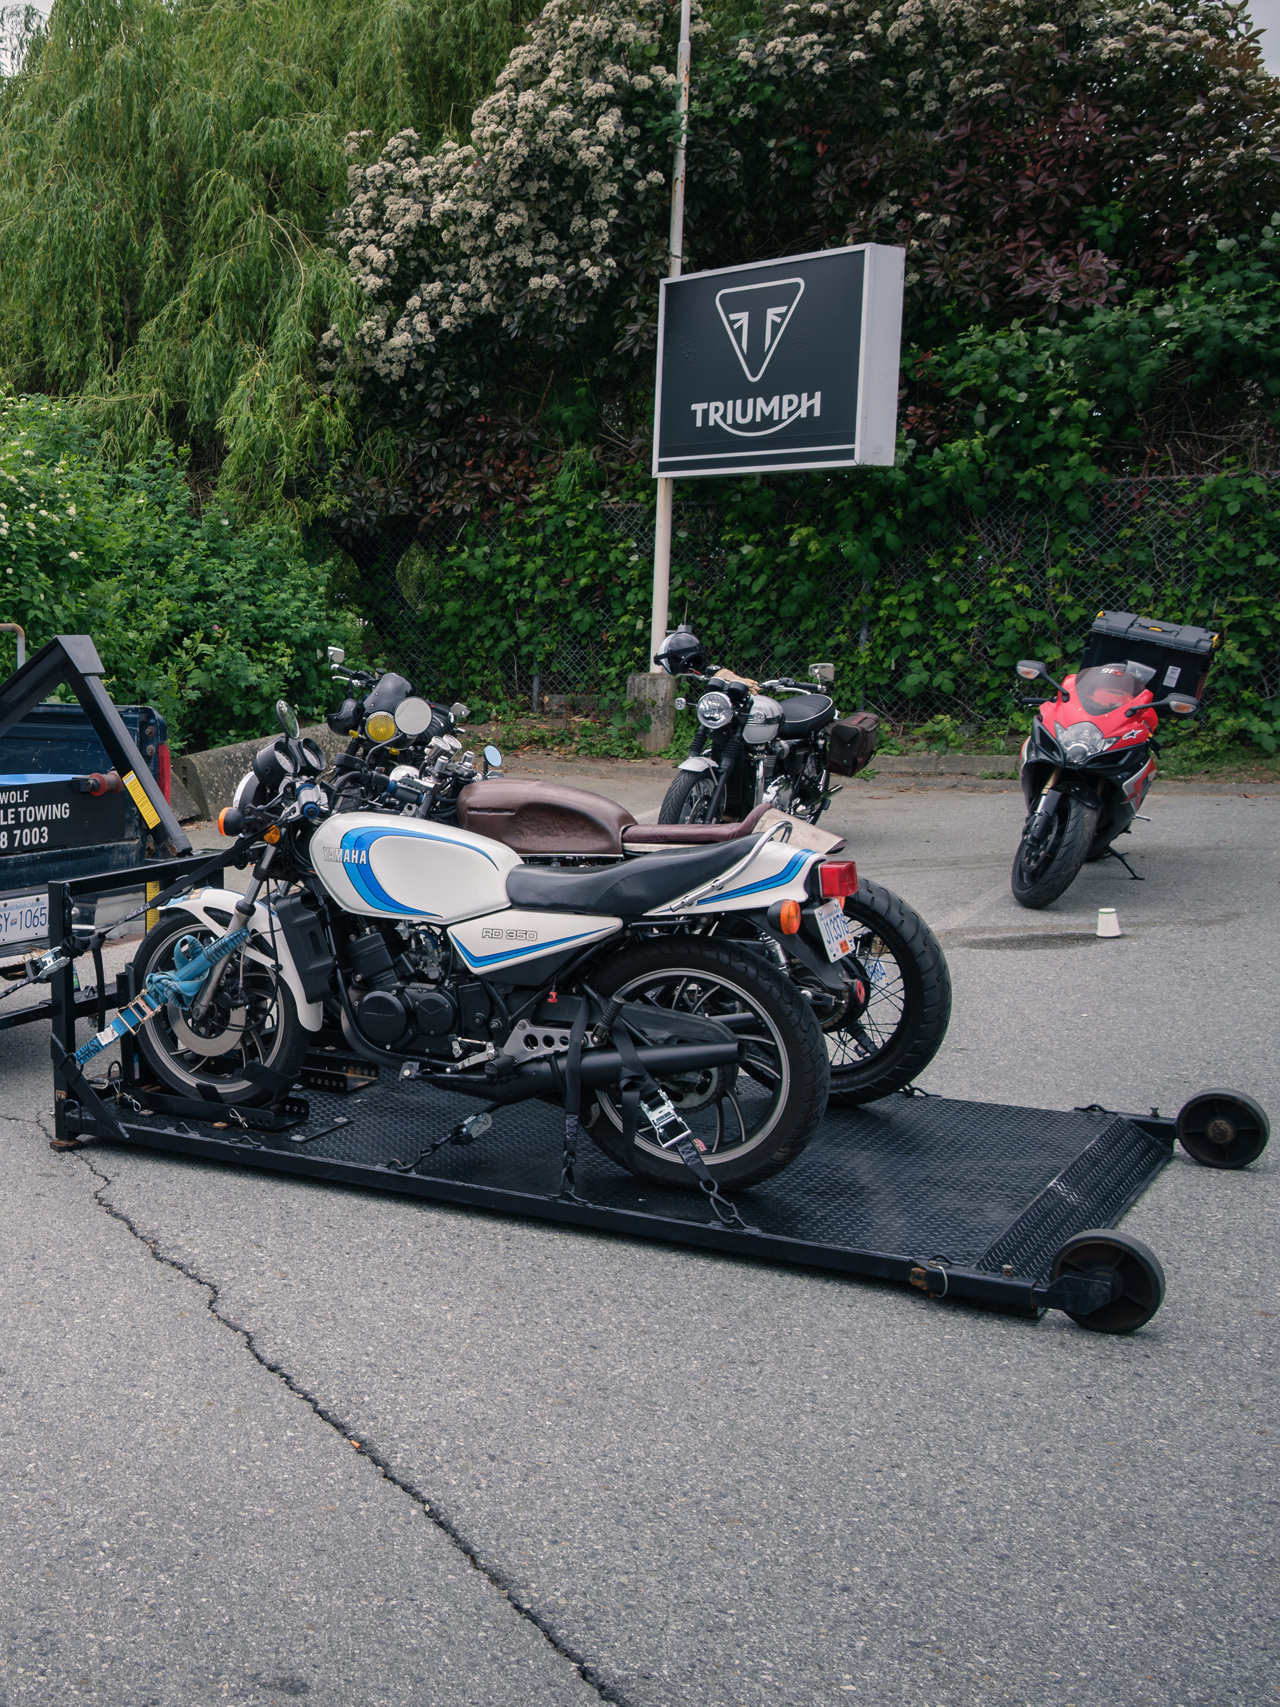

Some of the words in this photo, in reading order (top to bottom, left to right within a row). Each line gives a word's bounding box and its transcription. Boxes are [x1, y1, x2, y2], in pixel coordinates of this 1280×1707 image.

[691, 391, 822, 437] TRIUMPH
[18, 803, 70, 823] TOWING
[13, 826, 49, 848] 7003
[322, 846, 367, 865] YAMAHA
[19, 906, 48, 930] 1065
[481, 927, 503, 940] RD
[505, 929, 538, 942] 350
